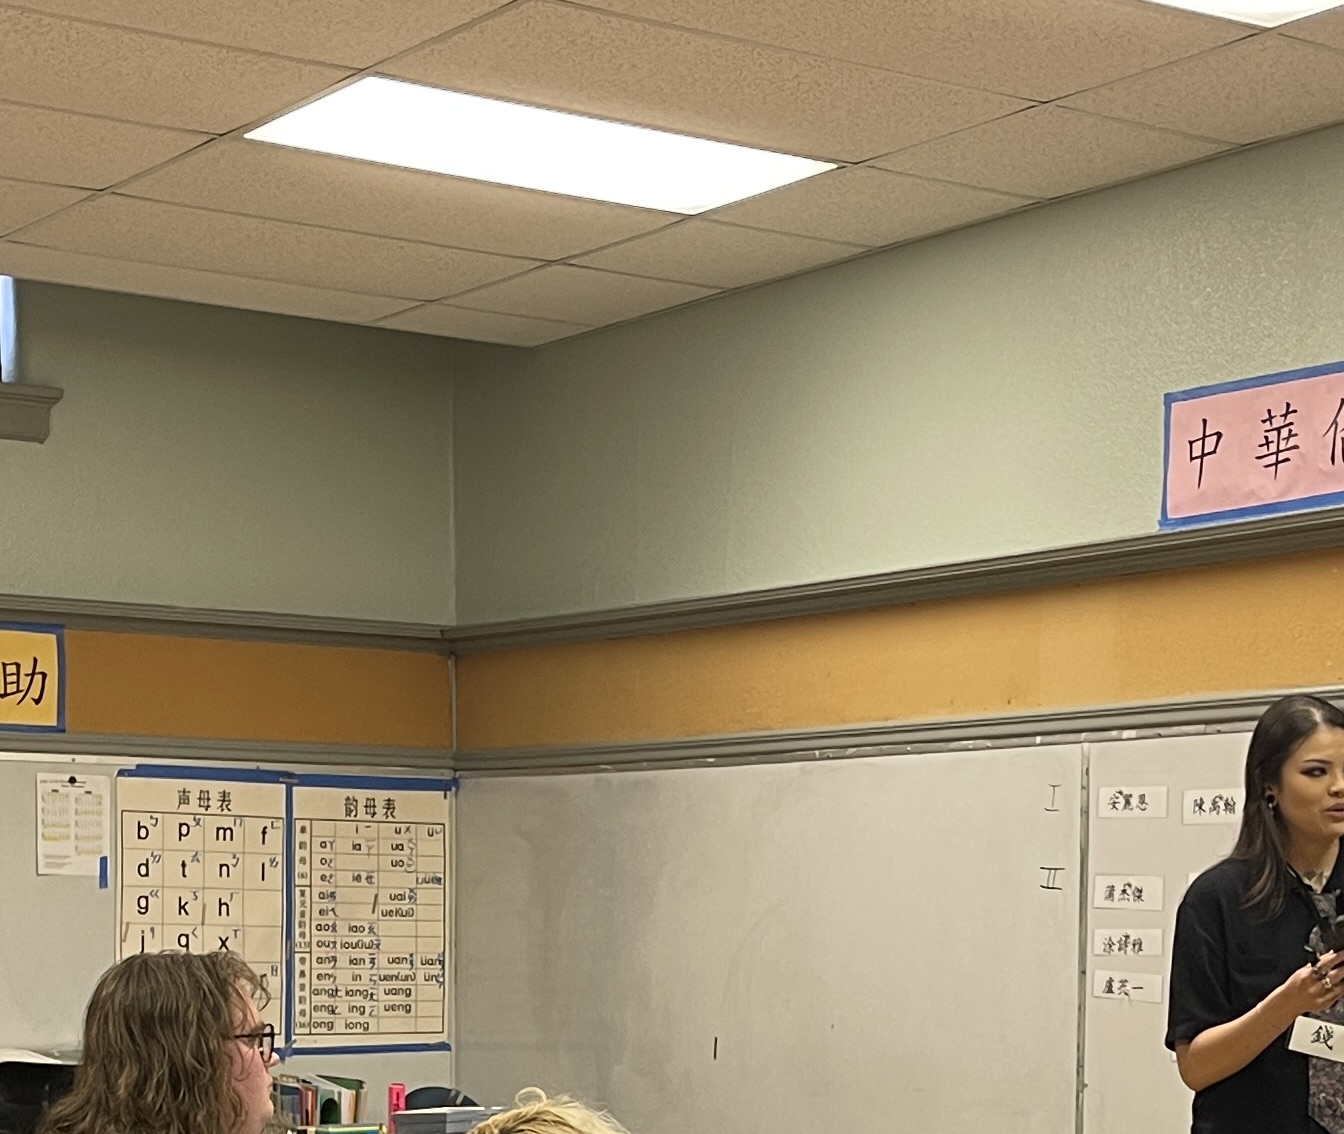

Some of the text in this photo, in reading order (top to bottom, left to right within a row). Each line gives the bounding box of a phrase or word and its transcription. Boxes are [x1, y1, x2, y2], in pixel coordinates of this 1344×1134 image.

[176, 787, 233, 813] 声母表
[344, 795, 397, 819] 韵母表
[137, 820, 149, 840] b
[178, 822, 190, 842] p
[215, 826, 234, 842] m
[260, 826, 268, 845] f
[137, 858, 150, 878] d
[180, 860, 187, 878] t
[219, 862, 230, 878] n
[137, 895, 150, 915] g
[178, 896, 189, 916] k
[218, 898, 230, 917] h
[139, 929, 145, 953] j
[177, 932, 190, 951] q
[218, 936, 229, 951] x
[384, 987, 412, 998] uang
[313, 1020, 334, 1031] ong
